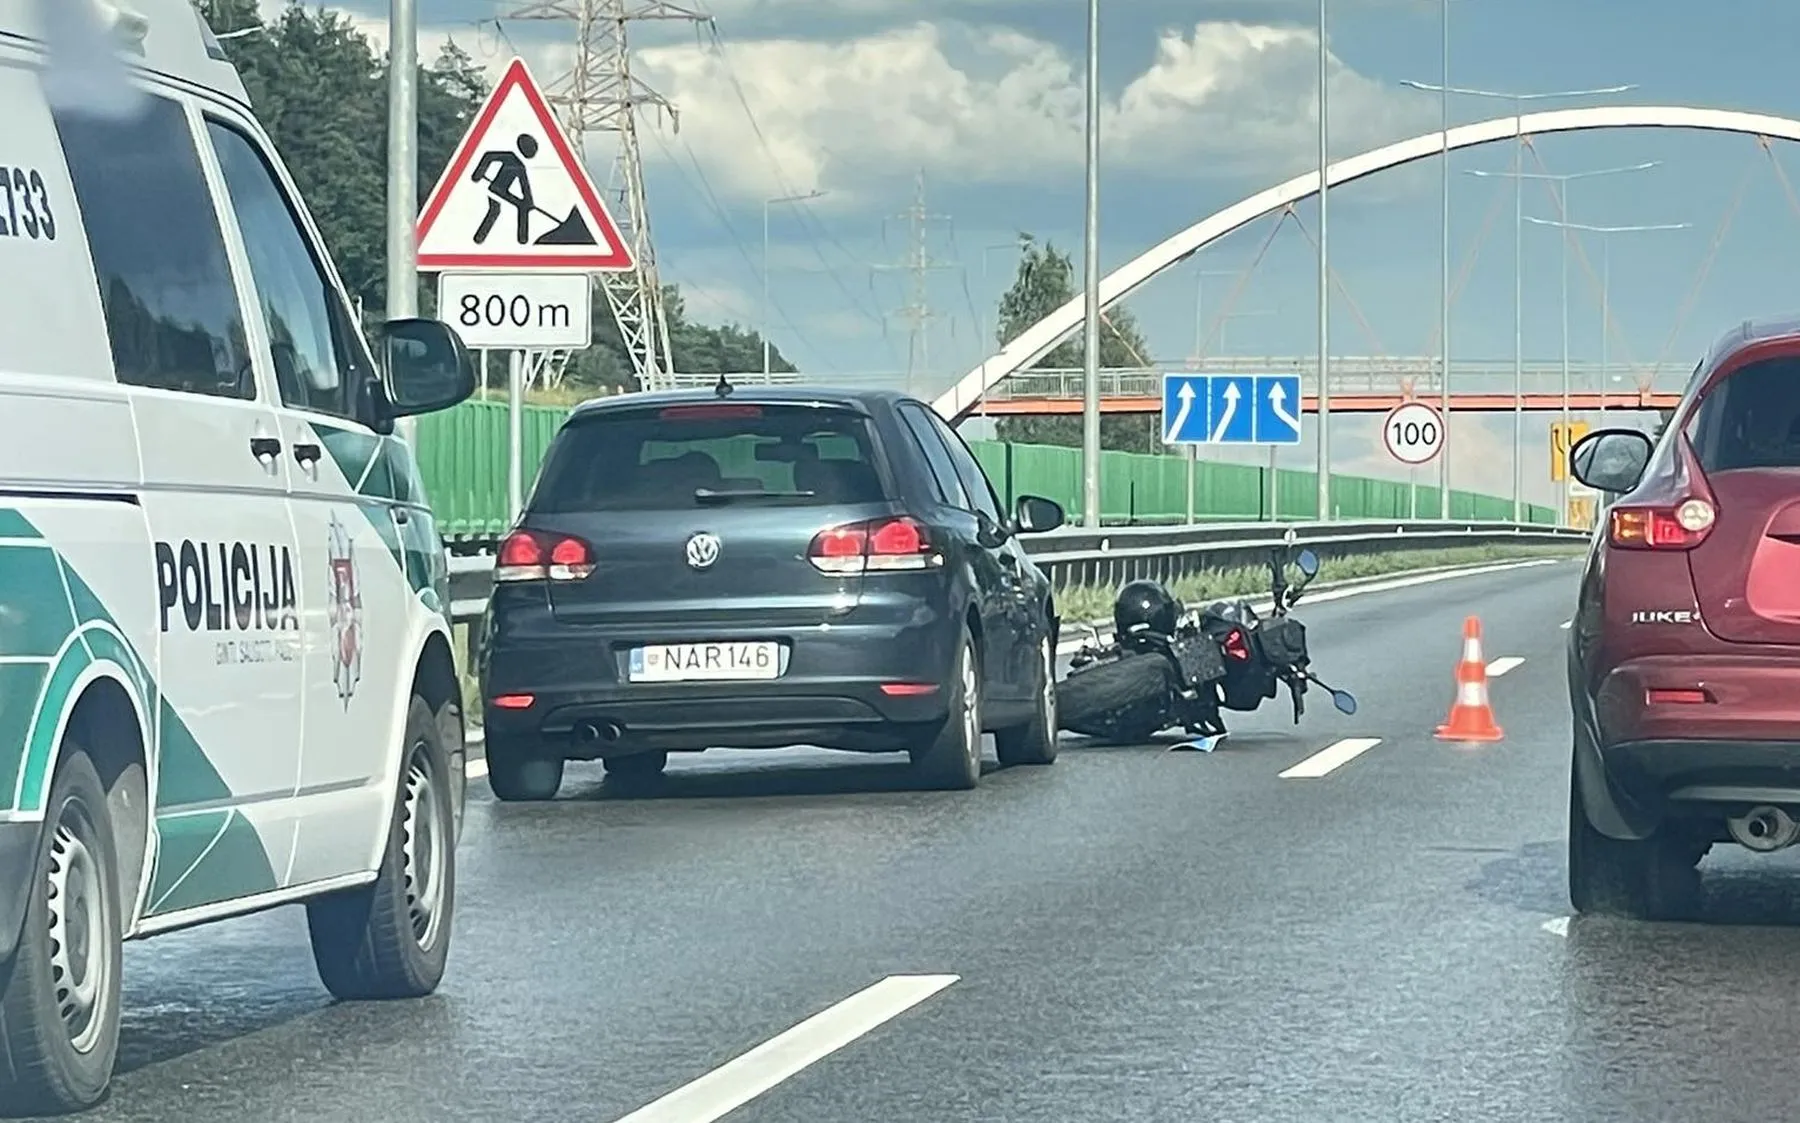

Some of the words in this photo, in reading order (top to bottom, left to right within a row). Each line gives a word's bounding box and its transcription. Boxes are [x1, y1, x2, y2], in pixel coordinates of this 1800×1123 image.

[0, 167, 55, 240] 733
[460, 294, 530, 326] 800
[538, 304, 569, 327] m
[1393, 422, 1436, 445] 100
[155, 539, 299, 632] POLICIJA
[1632, 611, 1691, 623] JUKE
[665, 645, 769, 670] NAR146
